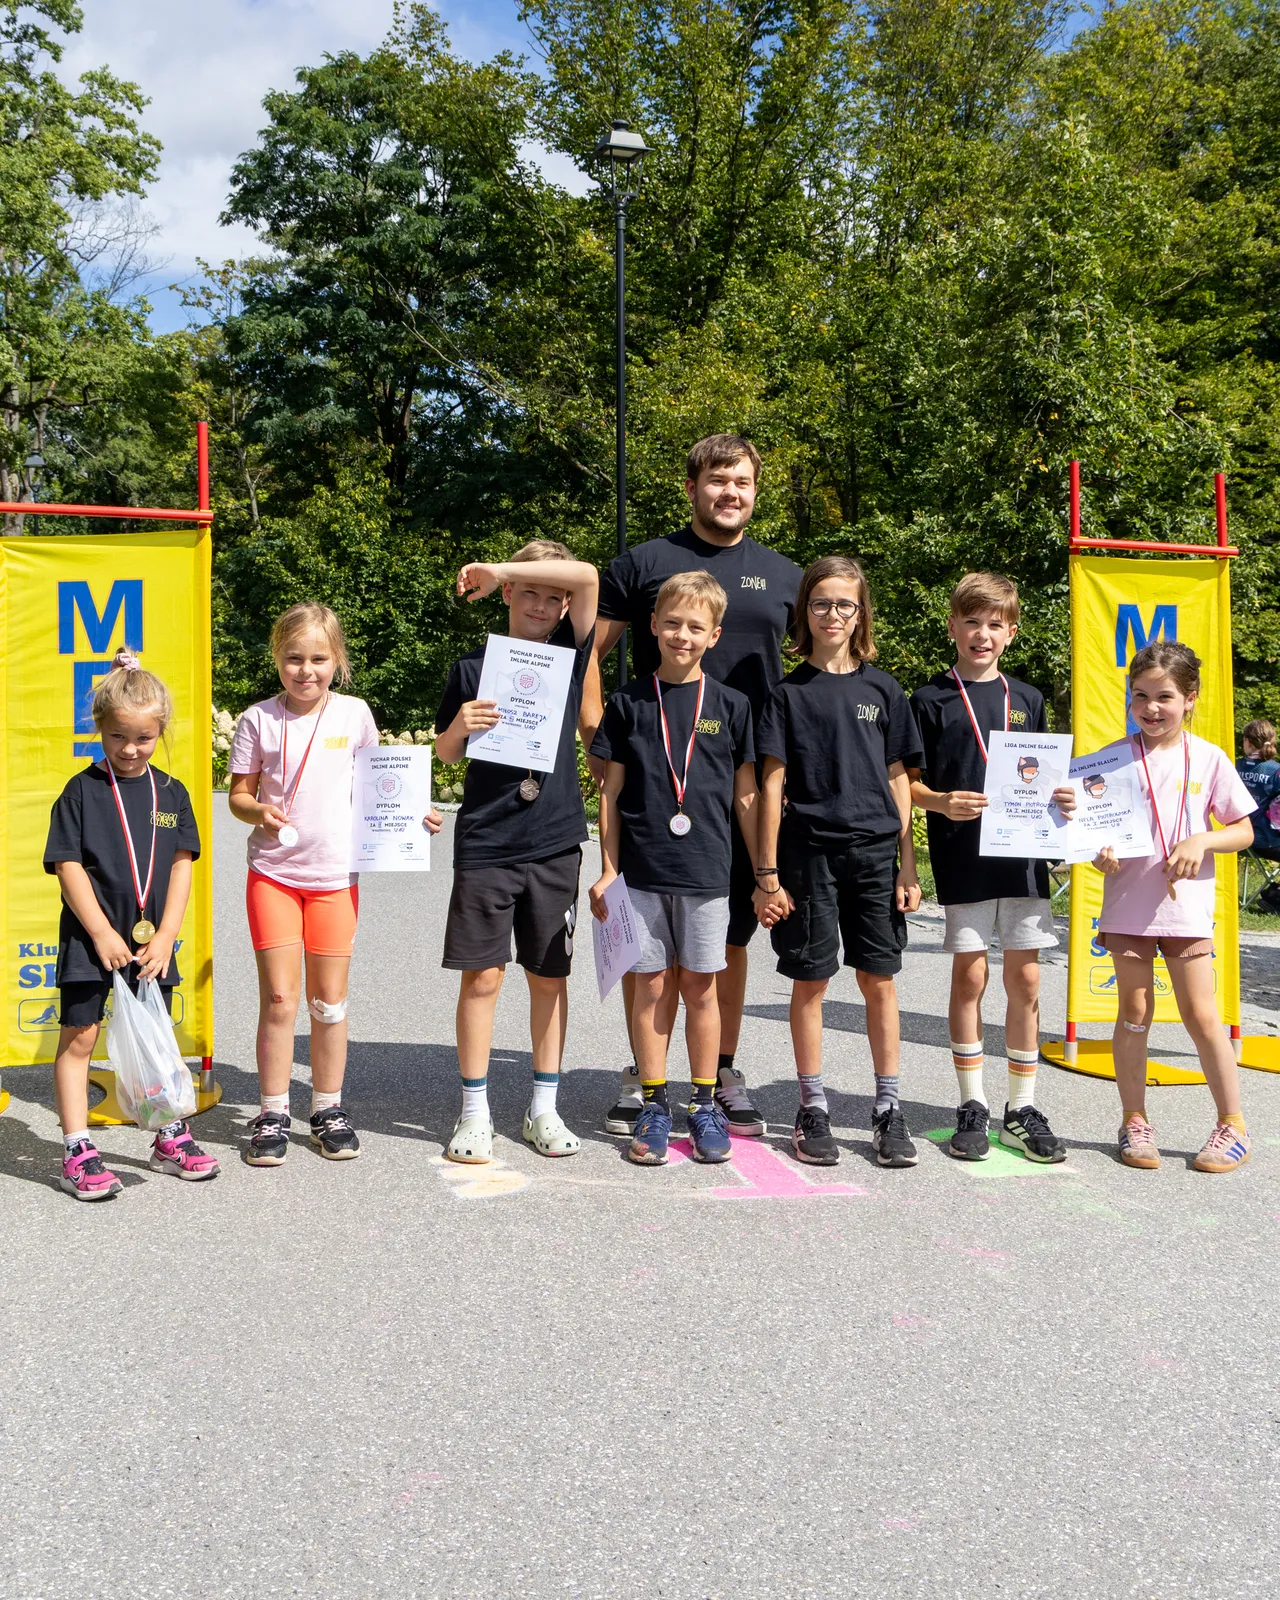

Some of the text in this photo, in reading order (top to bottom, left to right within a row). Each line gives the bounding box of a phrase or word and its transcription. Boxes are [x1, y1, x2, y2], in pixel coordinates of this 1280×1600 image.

[510, 649, 554, 662] PUCHAR POLSKI
[510, 657, 551, 668] INLINE ALPINE
[510, 696, 536, 706] DYPLOM
[516, 718, 538, 726] MIEJSCE
[1078, 763, 1096, 771] INLINE
[1097, 757, 1119, 766] SLALOM
[1087, 802, 1112, 811] DYPLOM
